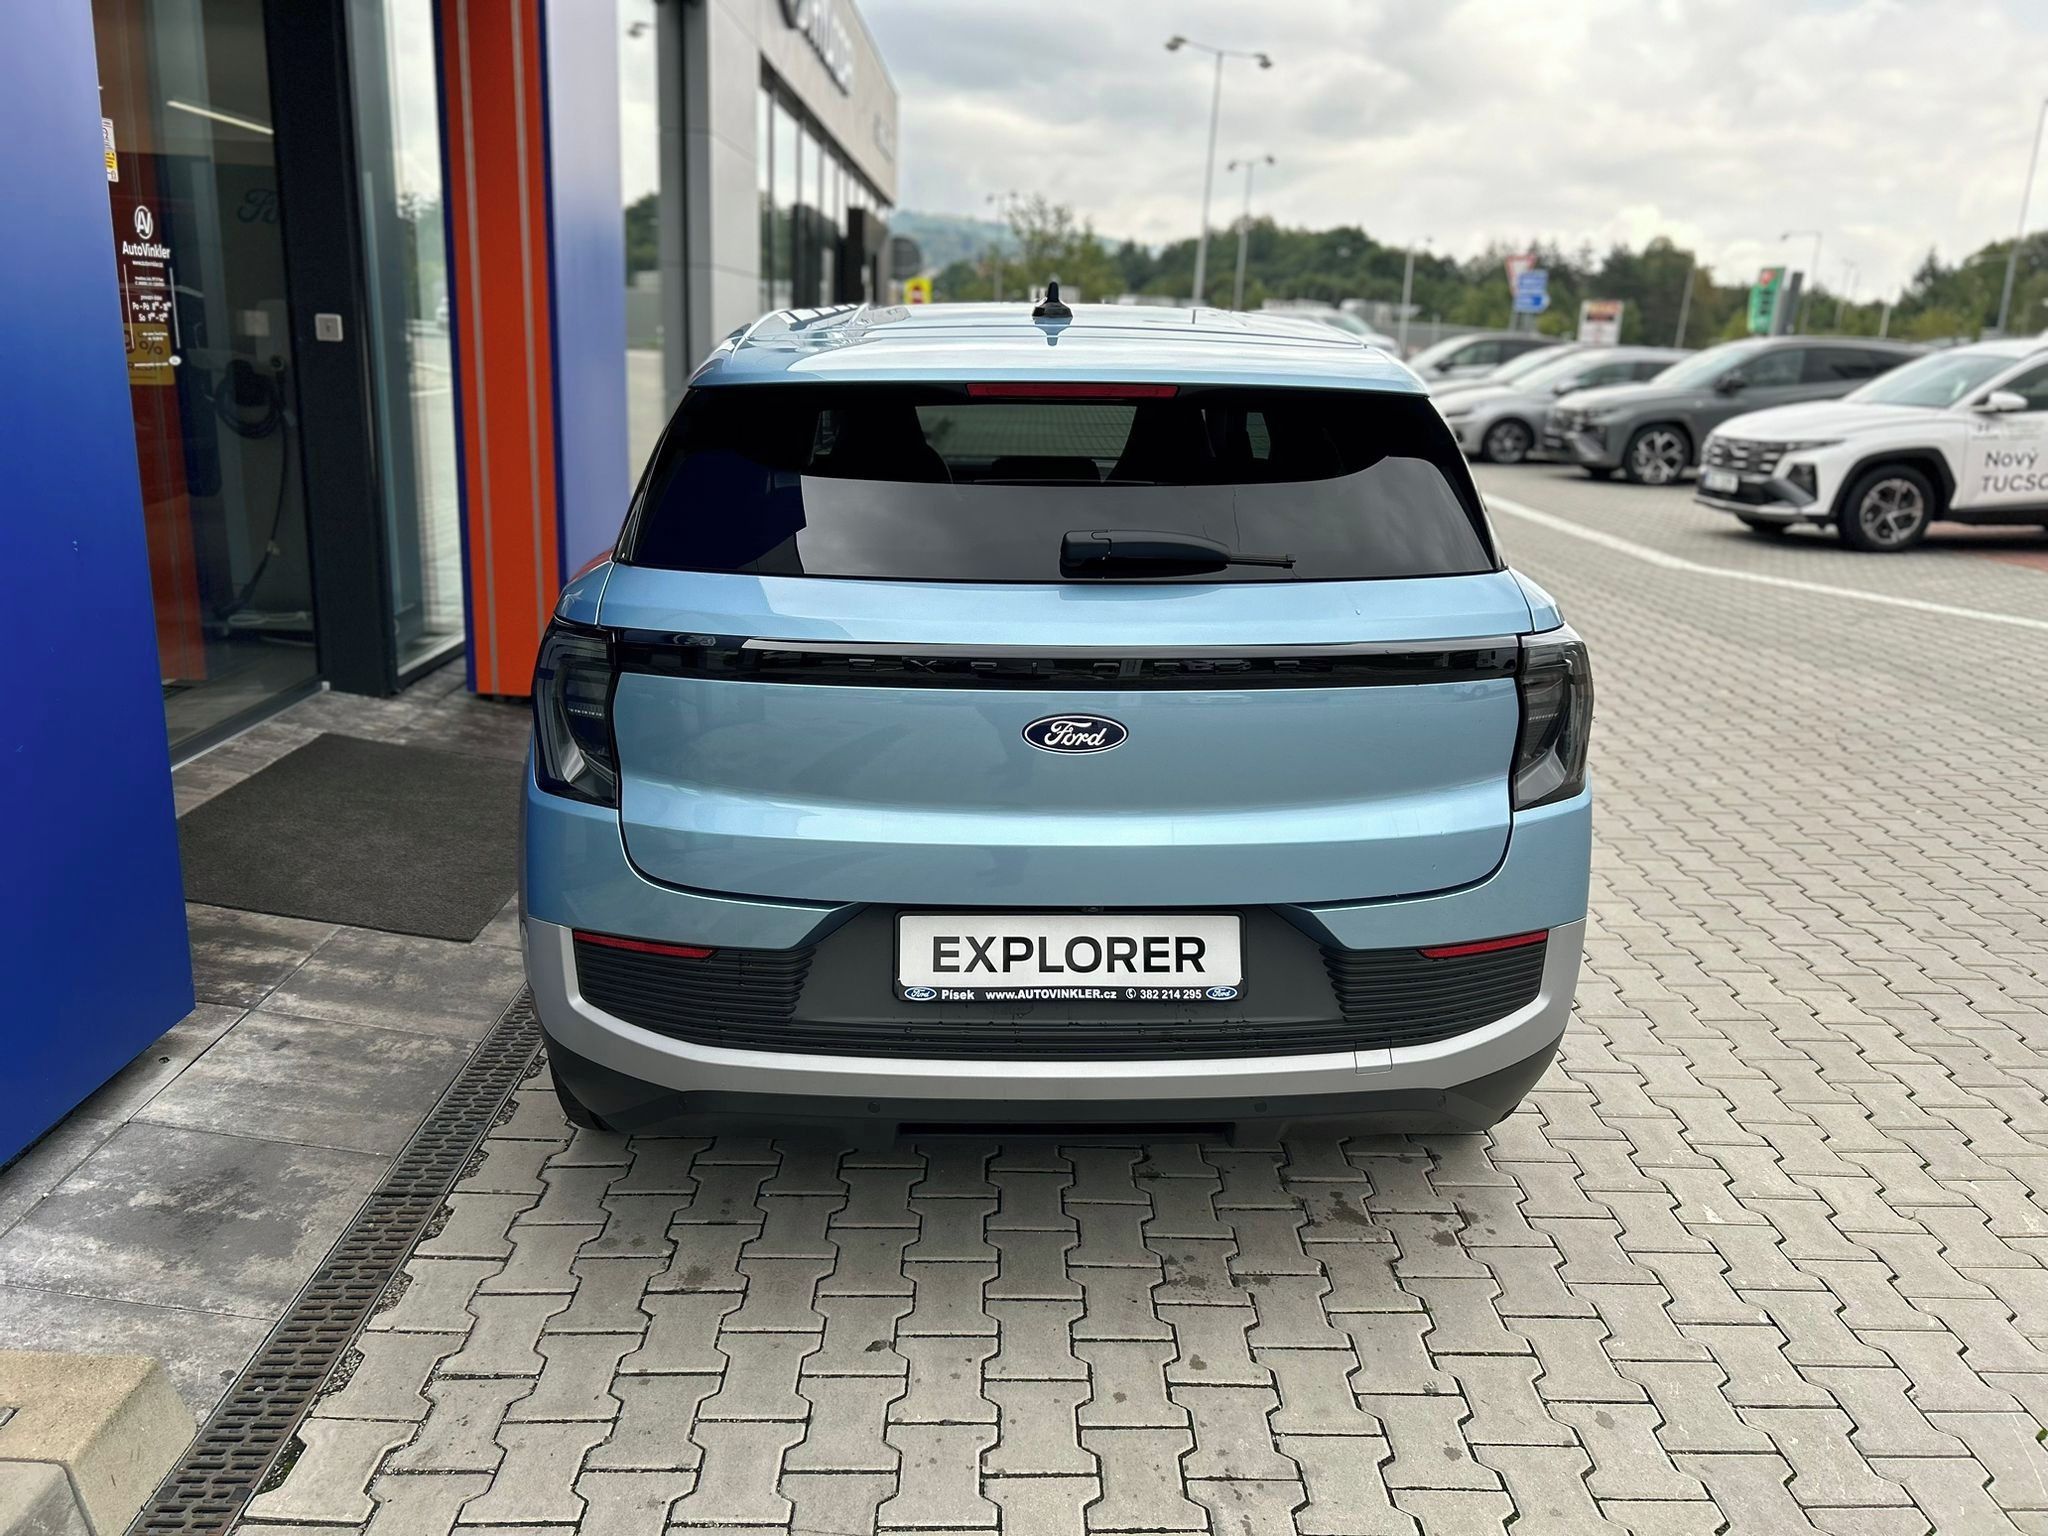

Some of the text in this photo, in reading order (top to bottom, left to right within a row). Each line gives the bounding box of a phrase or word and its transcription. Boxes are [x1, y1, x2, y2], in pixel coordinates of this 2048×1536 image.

[122, 241, 171, 259] AutoVinkler
[1044, 719, 1109, 747] Ford
[932, 936, 1207, 973] EXPLORER
[941, 989, 1202, 1000] Písek www.AUTOVINKLER.cz 382 214 295
